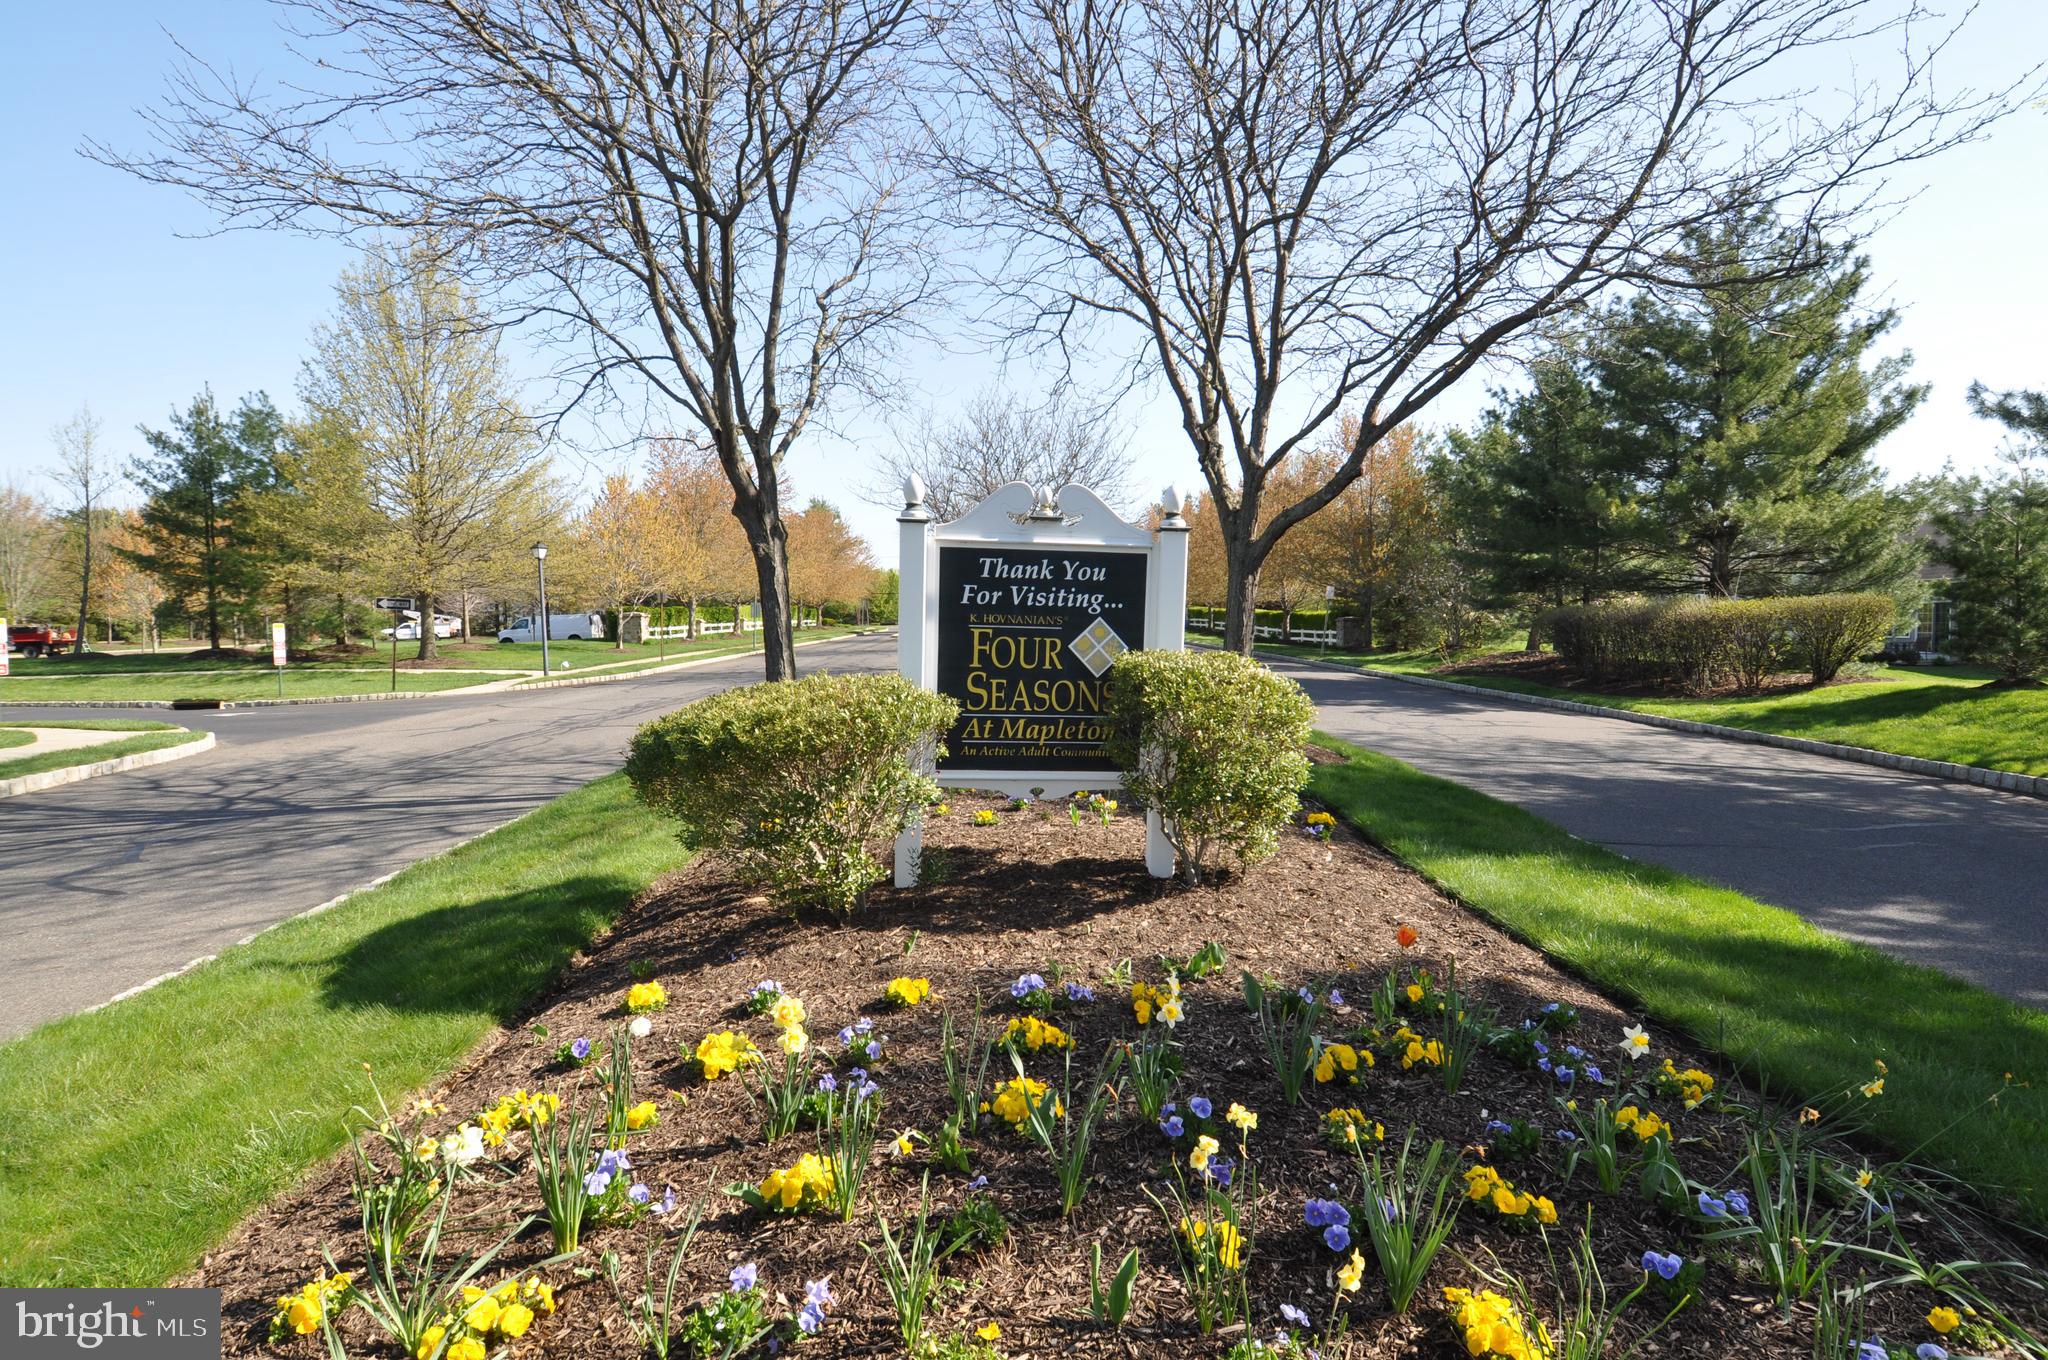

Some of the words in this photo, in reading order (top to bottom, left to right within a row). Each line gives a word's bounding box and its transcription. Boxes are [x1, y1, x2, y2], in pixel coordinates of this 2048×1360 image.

[978, 557, 1054, 581] Thank
[1062, 560, 1106, 581] You
[960, 584, 1002, 605] For
[1010, 585, 1123, 614] Visiting...
[983, 613, 1063, 625] HOVNANIAN'S
[969, 628, 1063, 669] FOUR
[966, 671, 1115, 713] SEASONS
[961, 718, 994, 738] At
[960, 746, 977, 756] An
[979, 746, 1015, 757] Active
[1019, 747, 1049, 757] Adult
